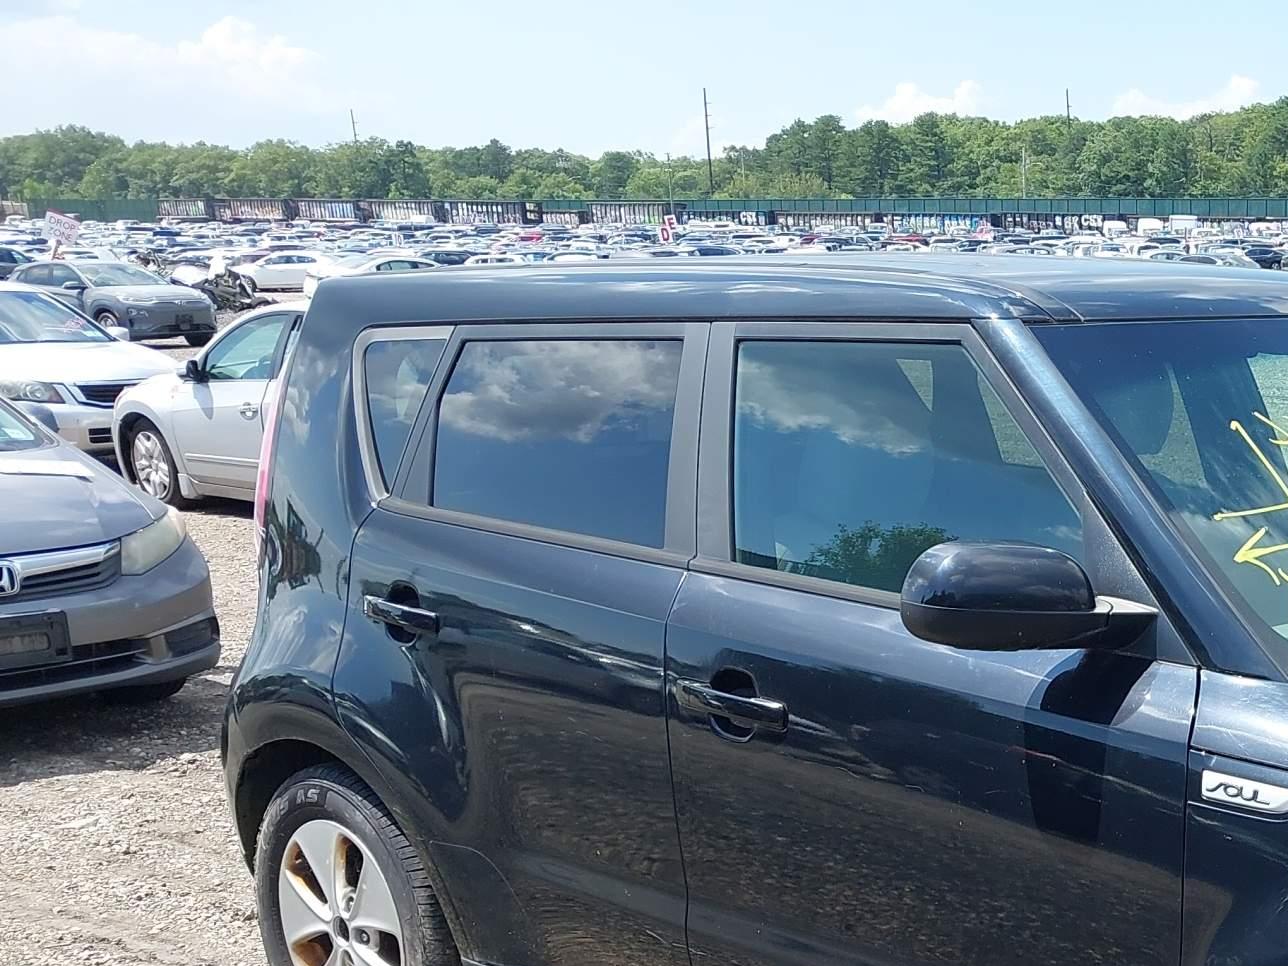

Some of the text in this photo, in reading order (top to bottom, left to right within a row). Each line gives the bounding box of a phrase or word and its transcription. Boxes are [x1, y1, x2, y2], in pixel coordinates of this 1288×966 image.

[49, 215, 76, 230] DROP
[667, 217, 676, 230] E
[661, 228, 670, 242] D
